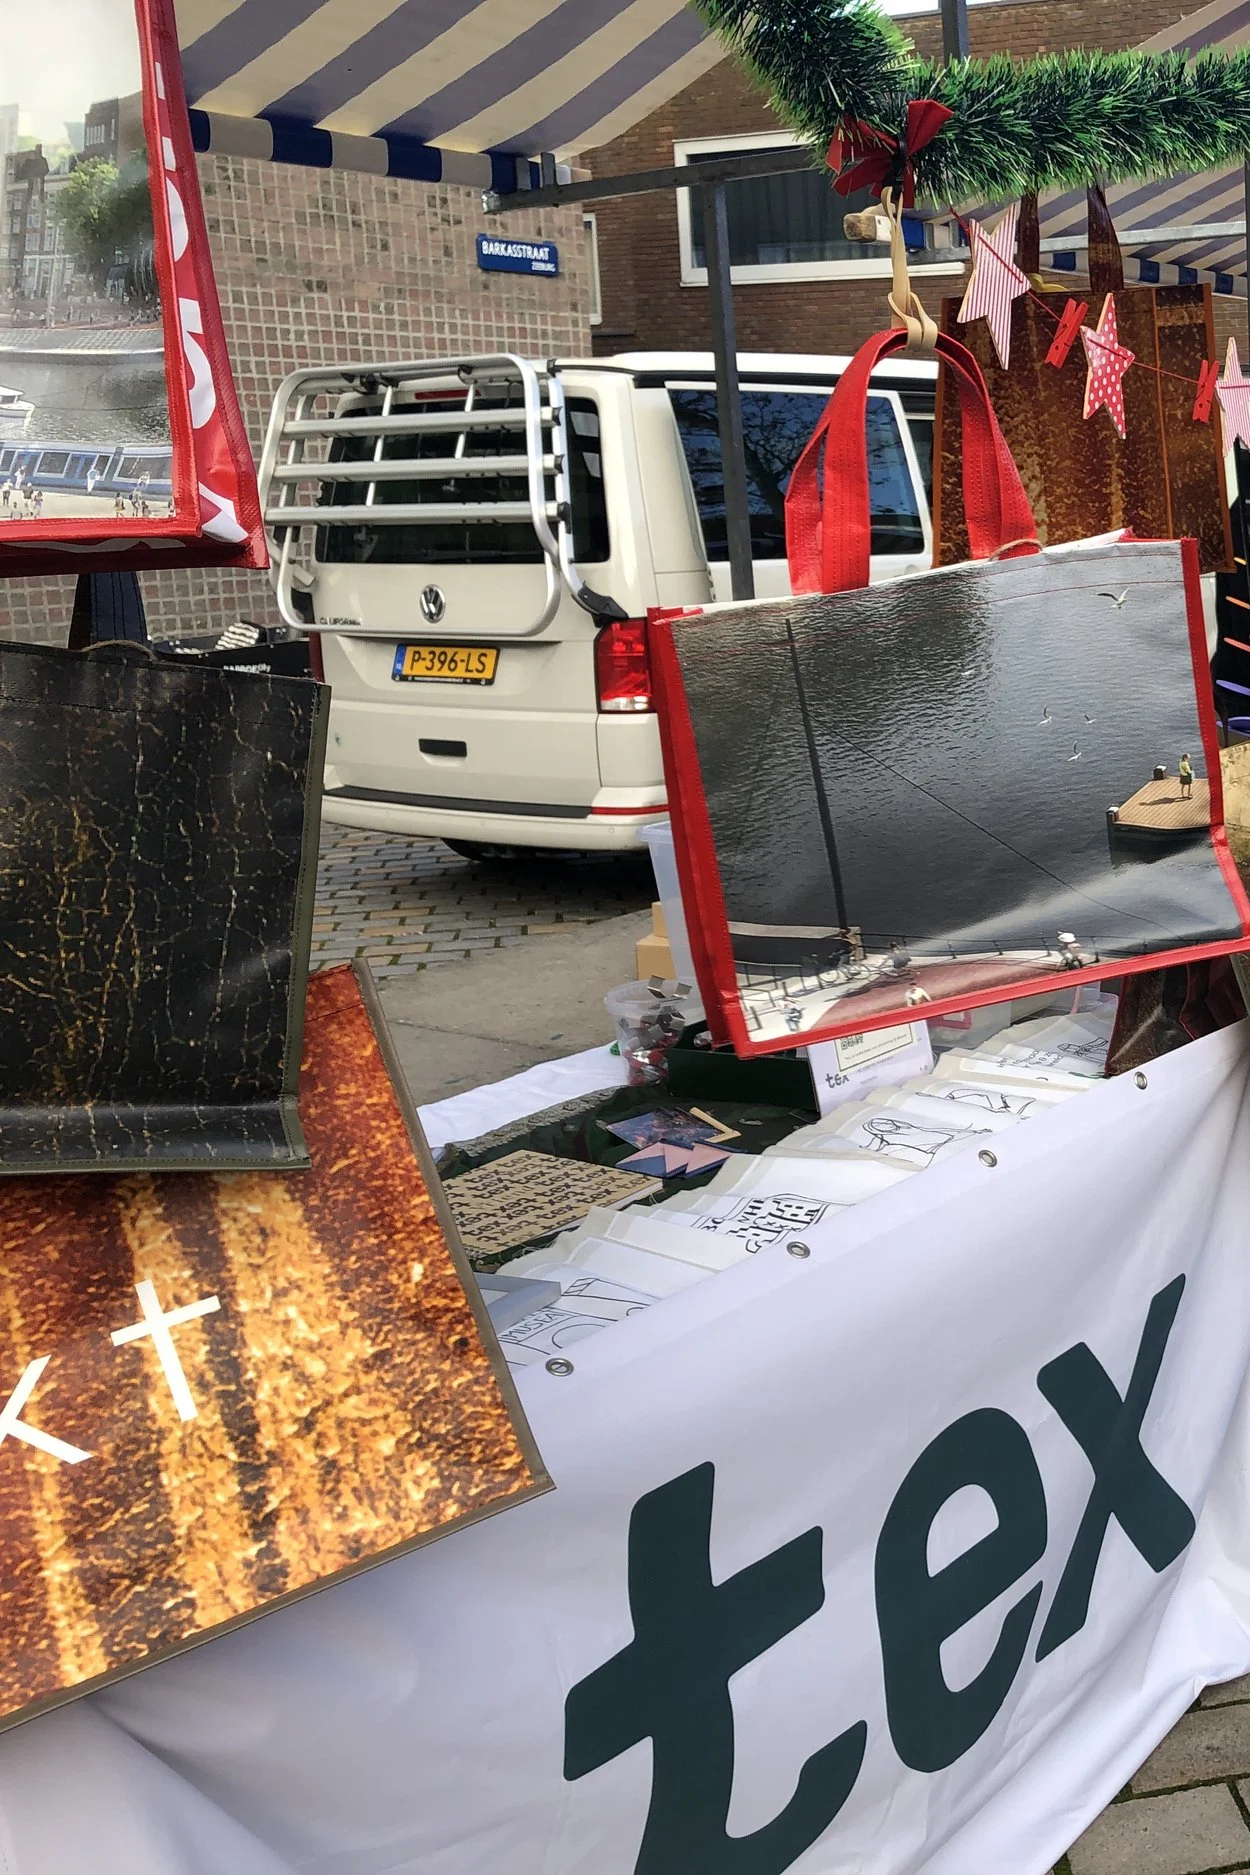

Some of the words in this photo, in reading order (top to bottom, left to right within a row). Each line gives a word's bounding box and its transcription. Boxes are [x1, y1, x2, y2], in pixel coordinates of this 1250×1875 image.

[482, 240, 550, 260] BARKASSTRAAT
[410, 649, 488, 673] P-396-LS
[825, 1072, 850, 1089] tex
[502, 1311, 566, 1339] MUSEA
[563, 1273, 1196, 1875] tex
